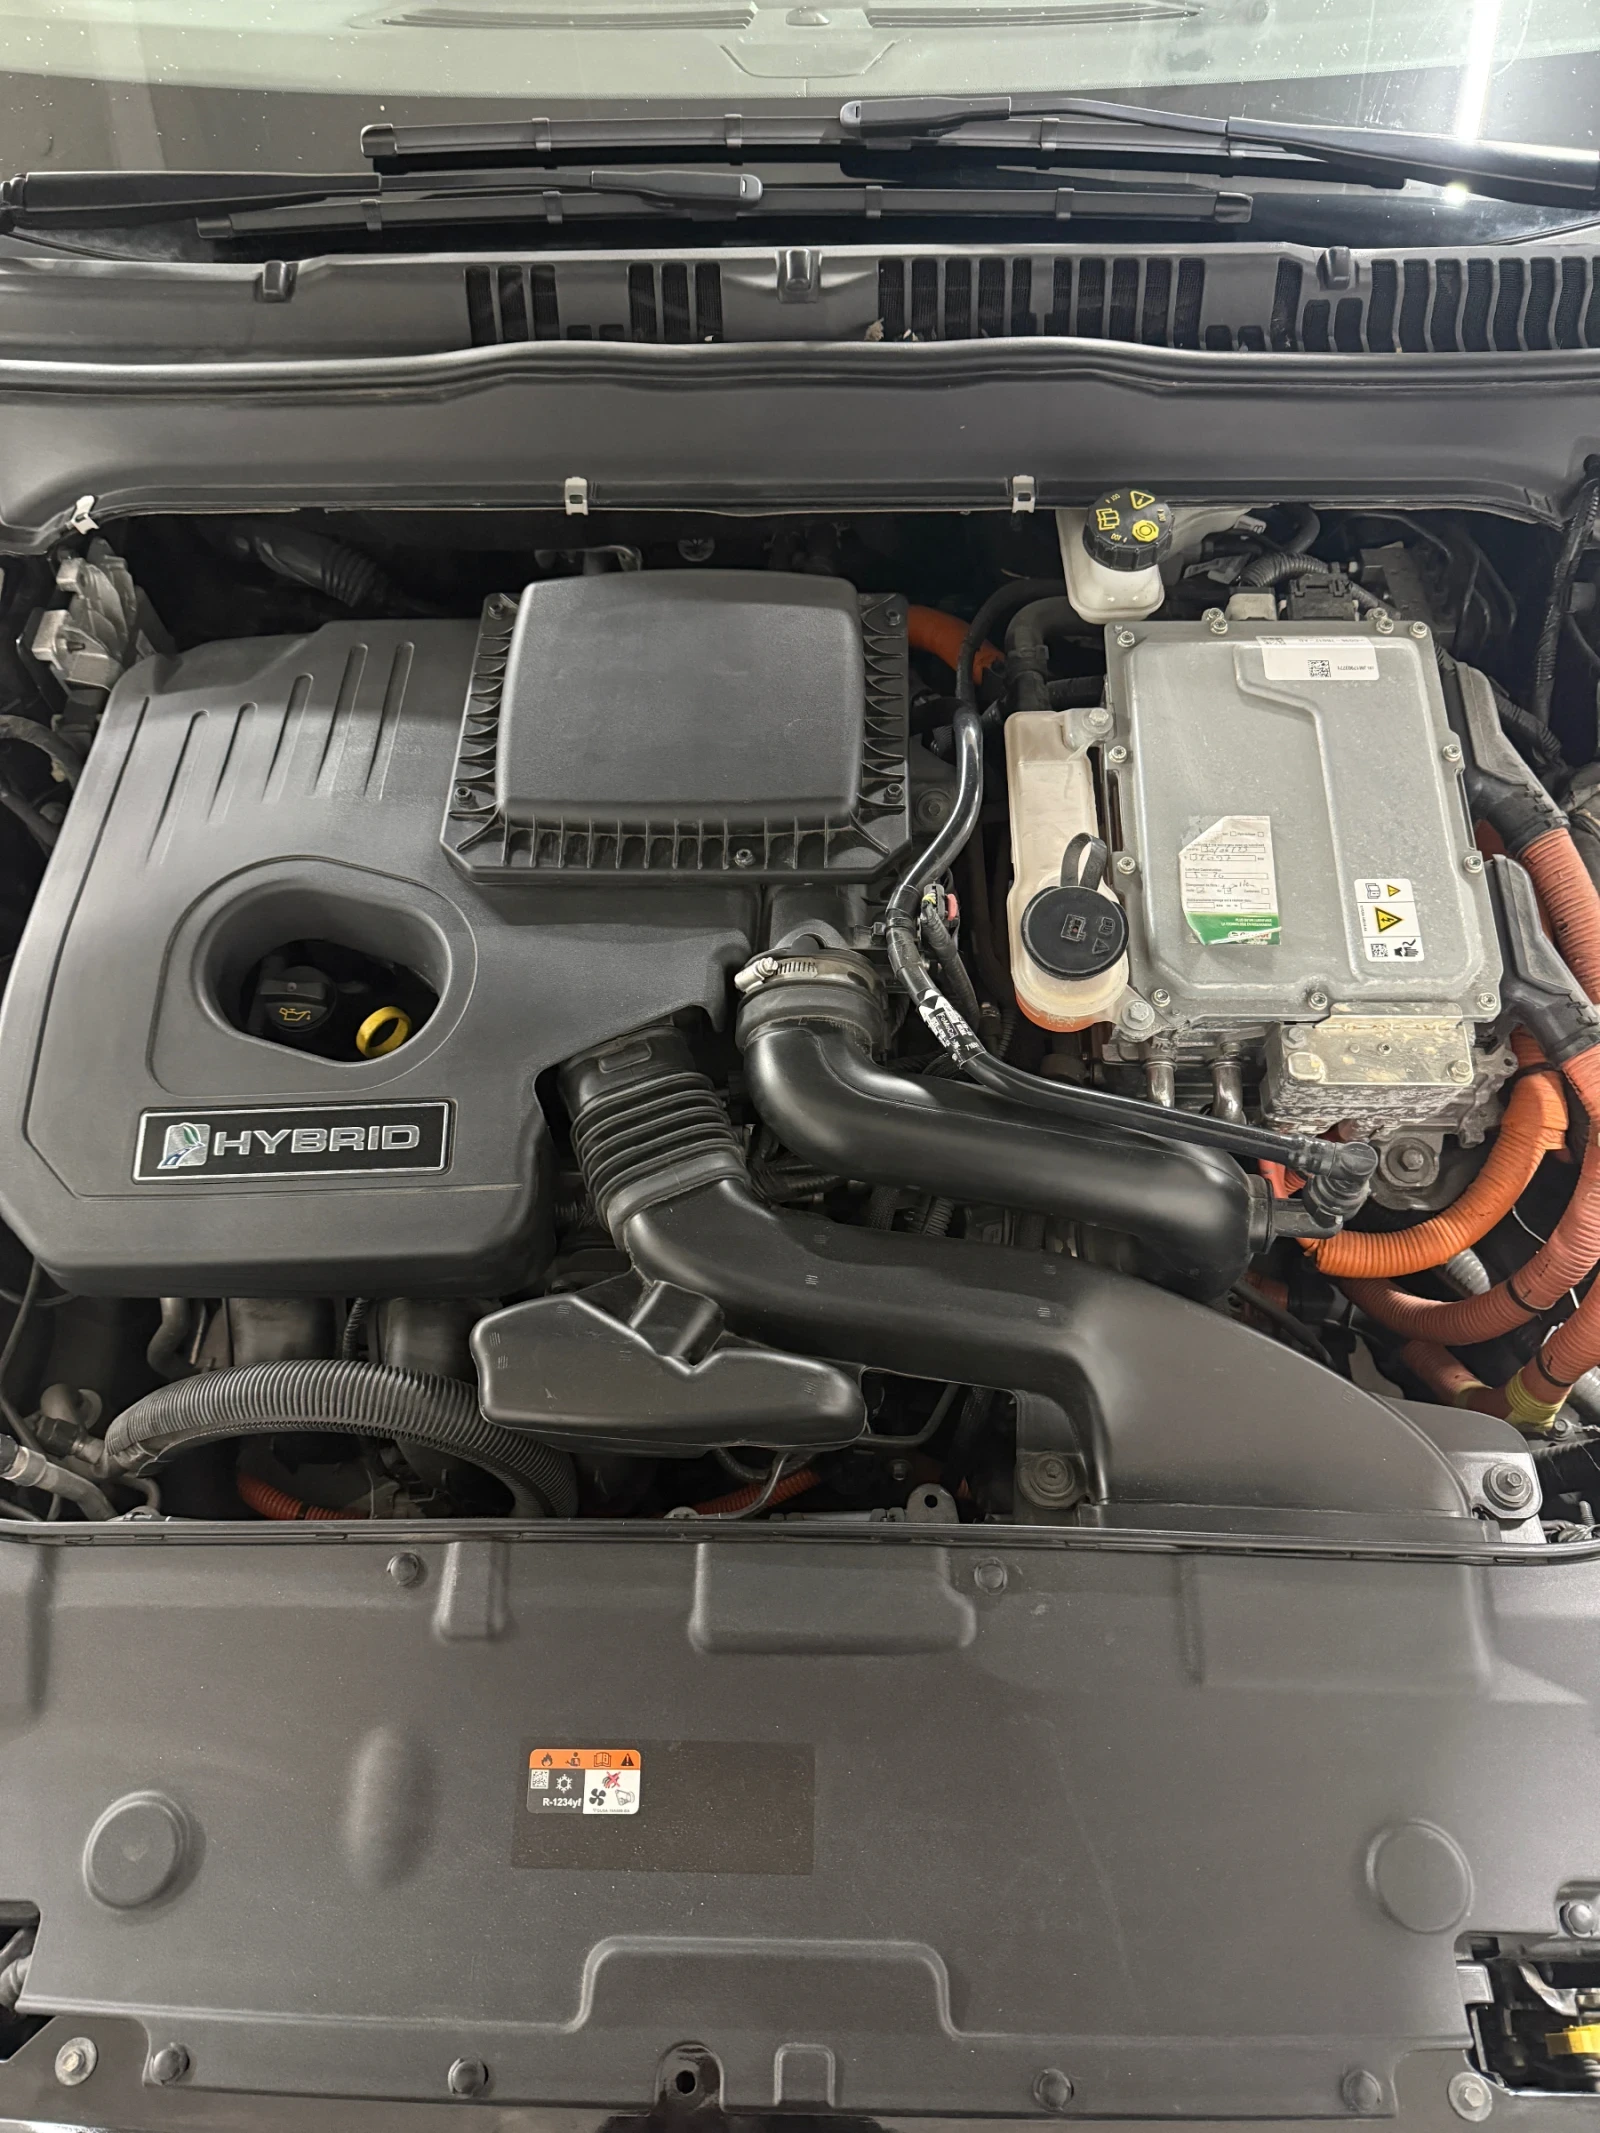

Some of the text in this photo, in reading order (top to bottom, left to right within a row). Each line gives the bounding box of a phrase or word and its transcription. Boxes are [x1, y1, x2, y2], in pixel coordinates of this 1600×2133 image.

[938, 1012, 956, 1039] FoMoCo
[214, 1124, 420, 1156] HYBRID
[542, 1798, 582, 1808] R-1234yf
